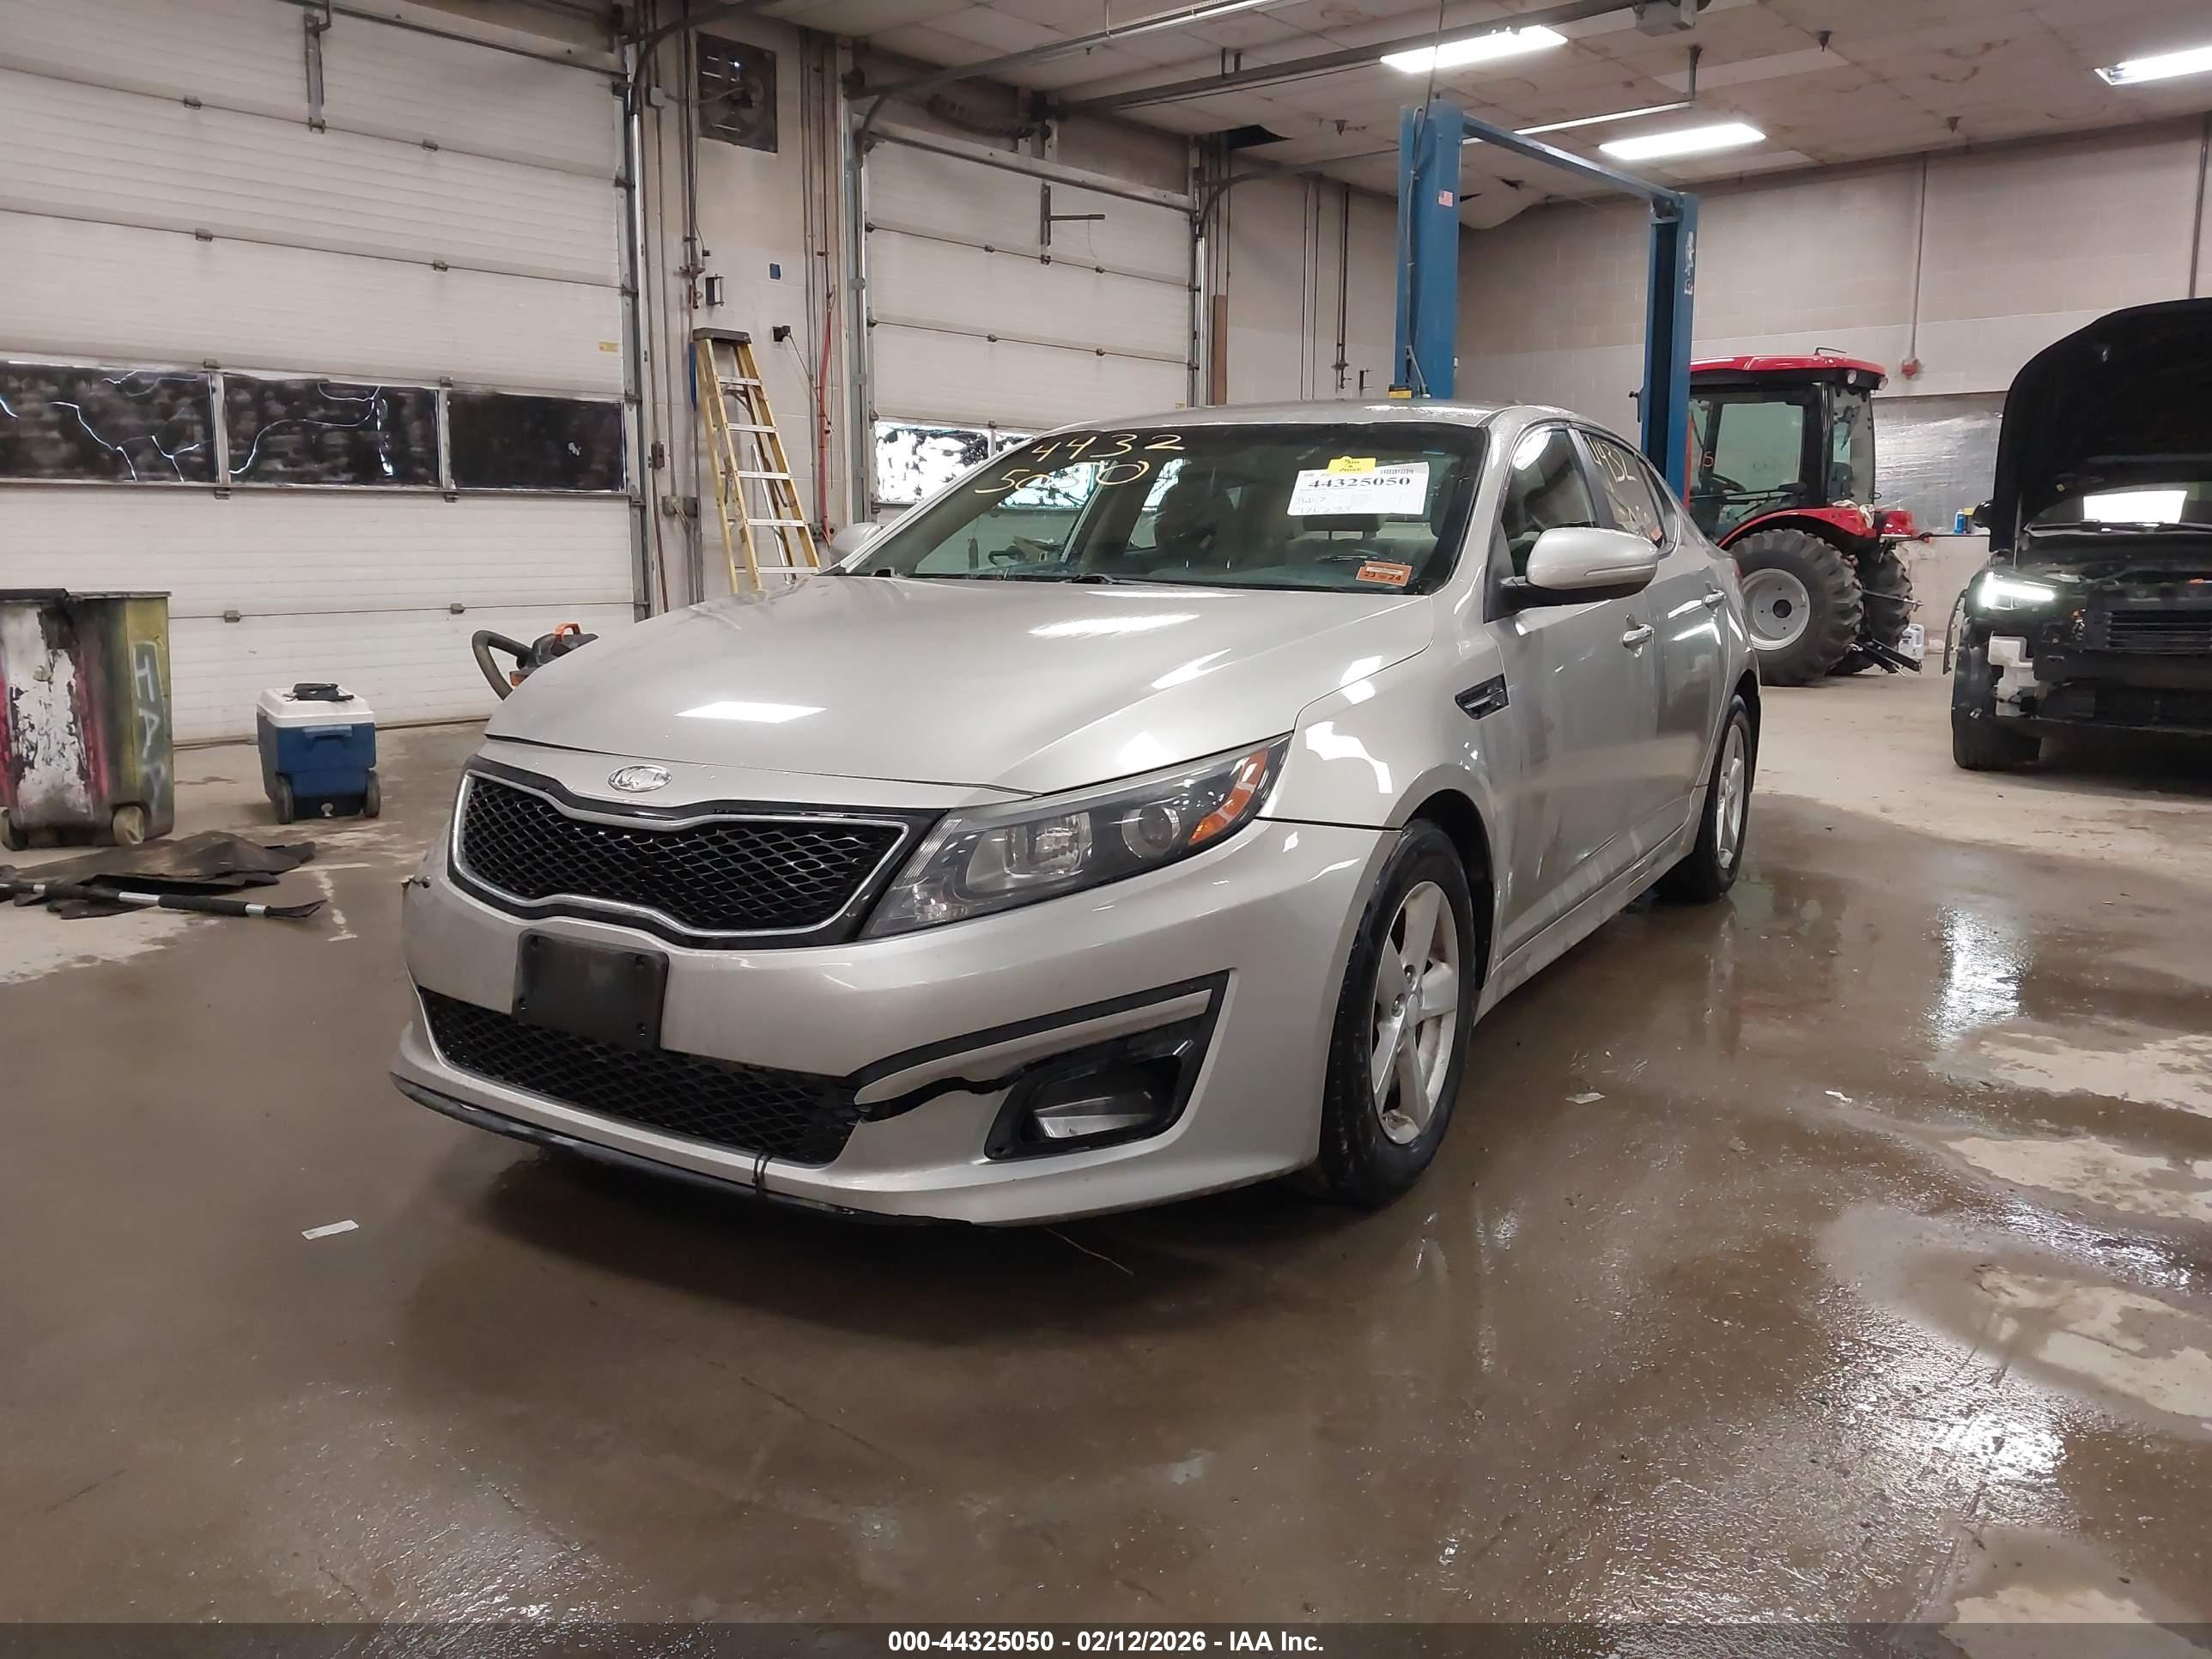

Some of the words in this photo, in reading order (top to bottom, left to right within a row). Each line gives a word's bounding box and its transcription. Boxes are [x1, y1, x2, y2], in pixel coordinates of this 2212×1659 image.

[1031, 434, 1185, 463] 4432
[975, 460, 1150, 495] 5050
[1308, 477, 1411, 489] 44325050
